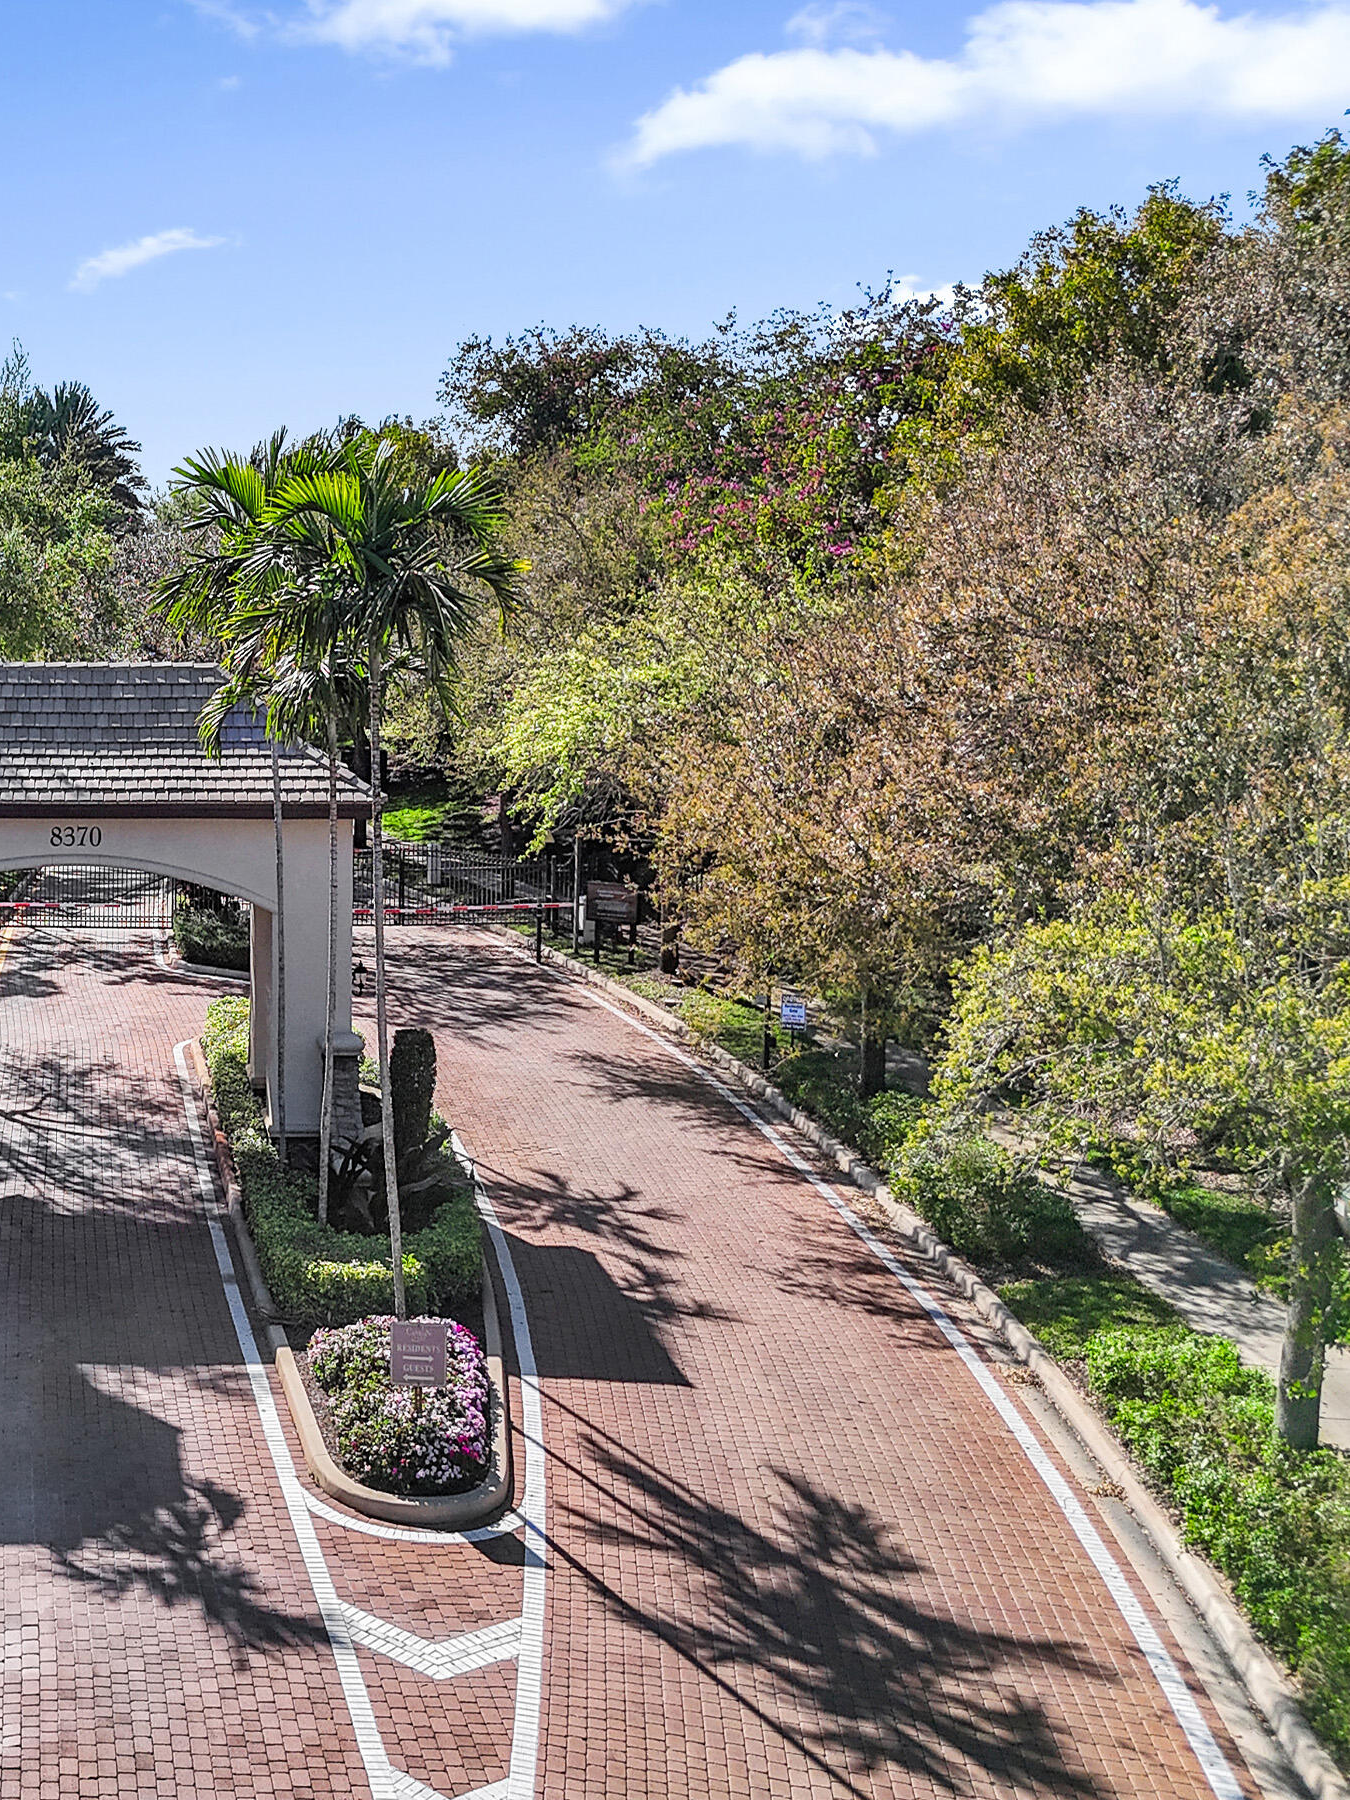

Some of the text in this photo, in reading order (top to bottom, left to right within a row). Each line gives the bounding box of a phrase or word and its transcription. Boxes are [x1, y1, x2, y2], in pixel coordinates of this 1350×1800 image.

[50, 826, 102, 847] 8370
[396, 1344, 440, 1353] RESIDENTS
[403, 1364, 434, 1373] GUESTS
